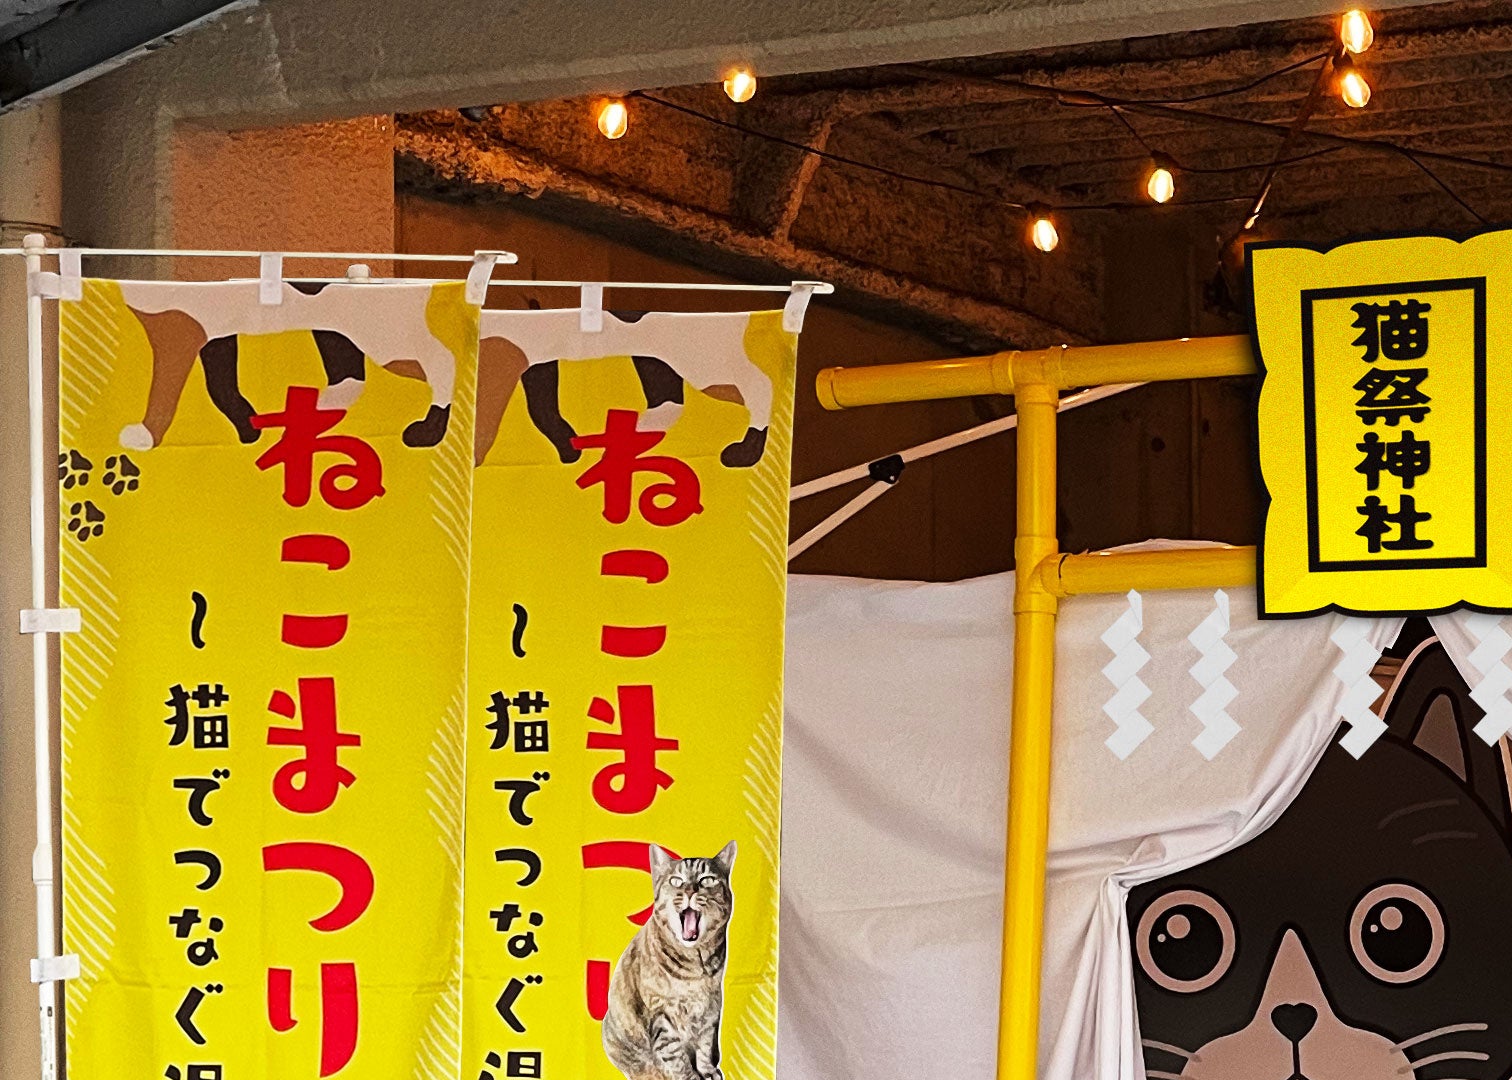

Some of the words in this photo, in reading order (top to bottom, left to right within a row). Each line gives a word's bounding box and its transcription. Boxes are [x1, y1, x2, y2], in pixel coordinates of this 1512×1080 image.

[1350, 298, 1434, 554] 猫祭神社
[250, 385, 387, 1078] ねこまつり
